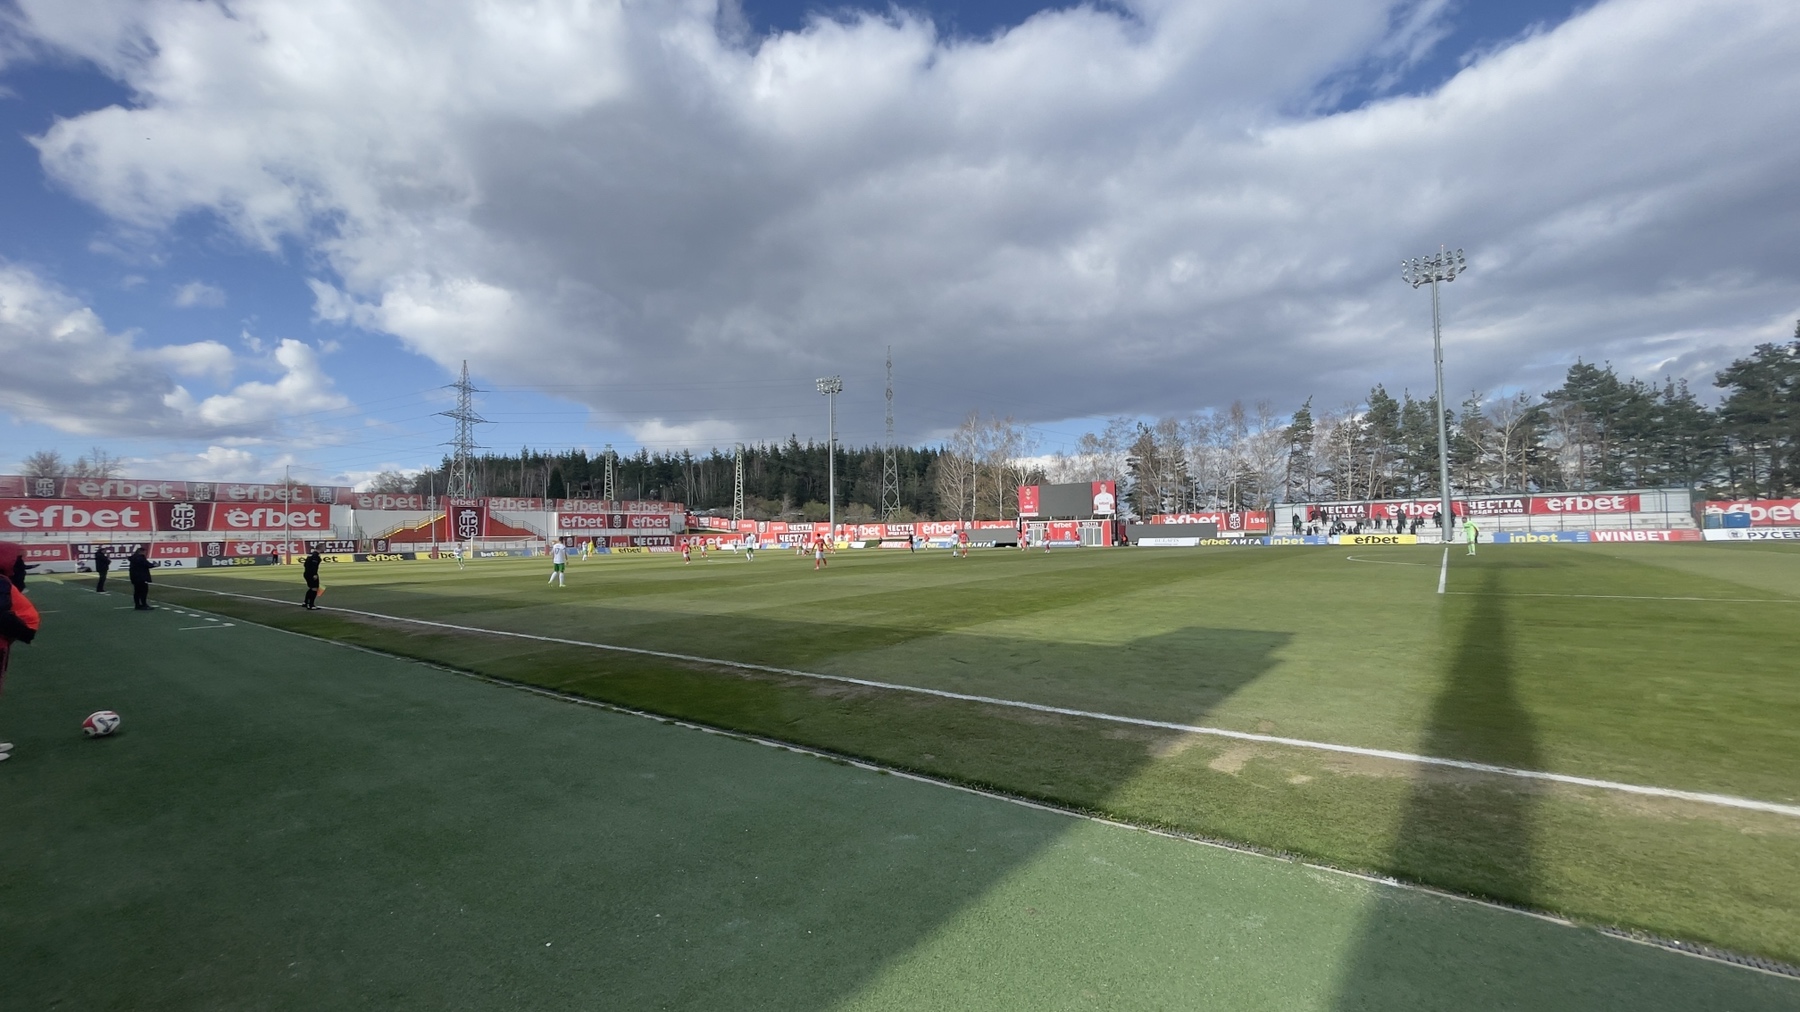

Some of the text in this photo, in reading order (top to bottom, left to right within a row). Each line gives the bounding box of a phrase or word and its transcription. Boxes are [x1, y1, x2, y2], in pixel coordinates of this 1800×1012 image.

[78, 480, 173, 499] efbet
[227, 485, 303, 501] efbet
[358, 494, 418, 509] efbet
[488, 498, 536, 511] efbet
[563, 500, 604, 512] efbet
[1469, 500, 1523, 510] ЧЕСТТА
[1546, 496, 1625, 511] efbet
[628, 502, 665, 513] efbet
[5, 505, 140, 528] efbet
[226, 508, 322, 528] efbet
[561, 516, 606, 528] efbet
[632, 517, 669, 528] efbet
[887, 524, 914, 532] ЧЕСТТА
[922, 523, 957, 535] efbet
[633, 537, 671, 546] ЧЕСТТА
[1199, 537, 1231, 546] efbet
[1353, 535, 1399, 544] efbet
[1509, 532, 1558, 543] inbet
[1594, 531, 1672, 542] WINBET
[26, 549, 61, 557] 1948
[234, 541, 299, 555] efbet
[212, 557, 256, 566] bet365
[366, 553, 404, 562] efbet
